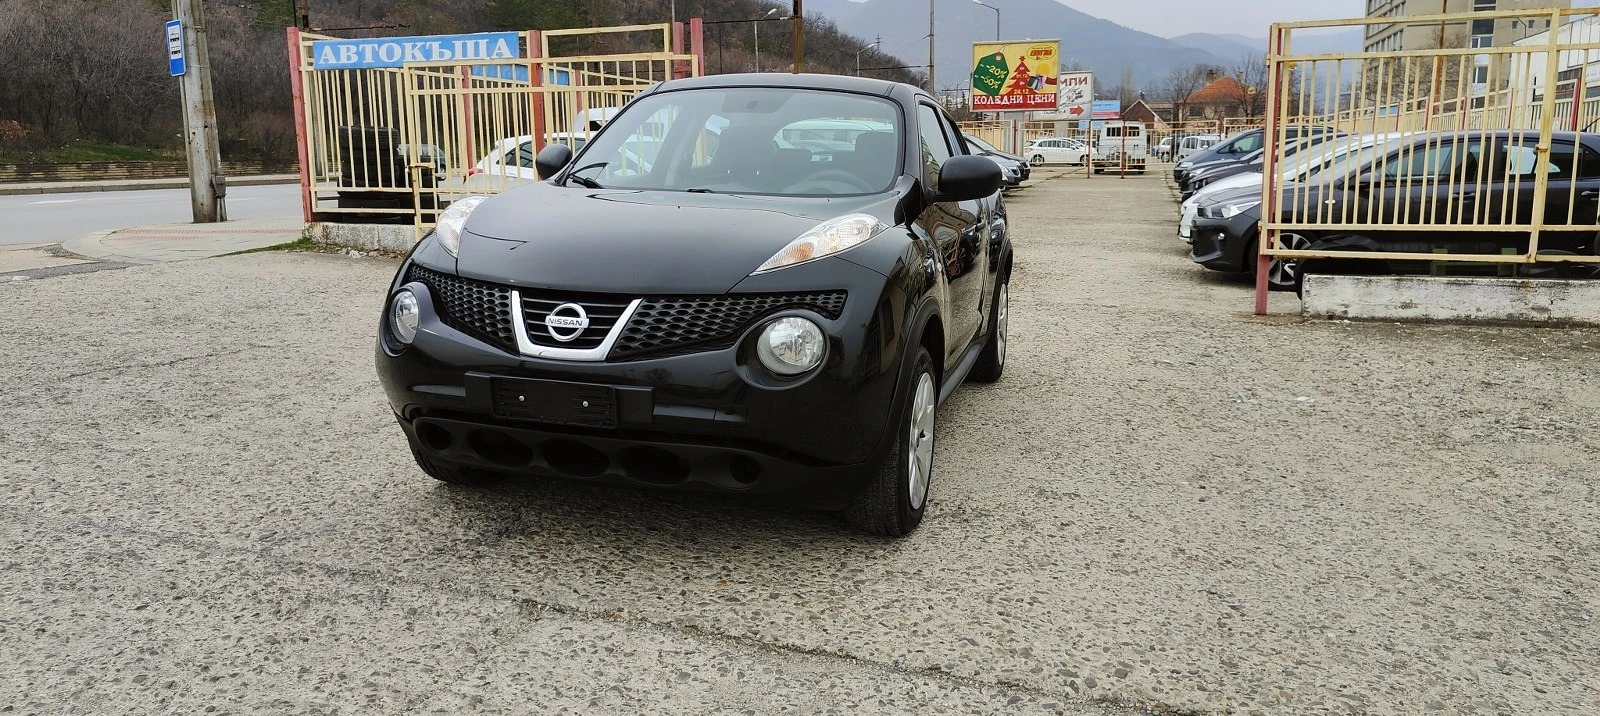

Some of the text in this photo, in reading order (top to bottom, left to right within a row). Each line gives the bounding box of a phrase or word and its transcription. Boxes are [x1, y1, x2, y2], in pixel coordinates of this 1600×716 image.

[318, 38, 514, 64] АВТОКЪЩА
[986, 65, 1008, 79] -20%
[973, 94, 1055, 105] КОЛЕДНИ ЦЕНИ
[547, 318, 583, 326] NISSAN
